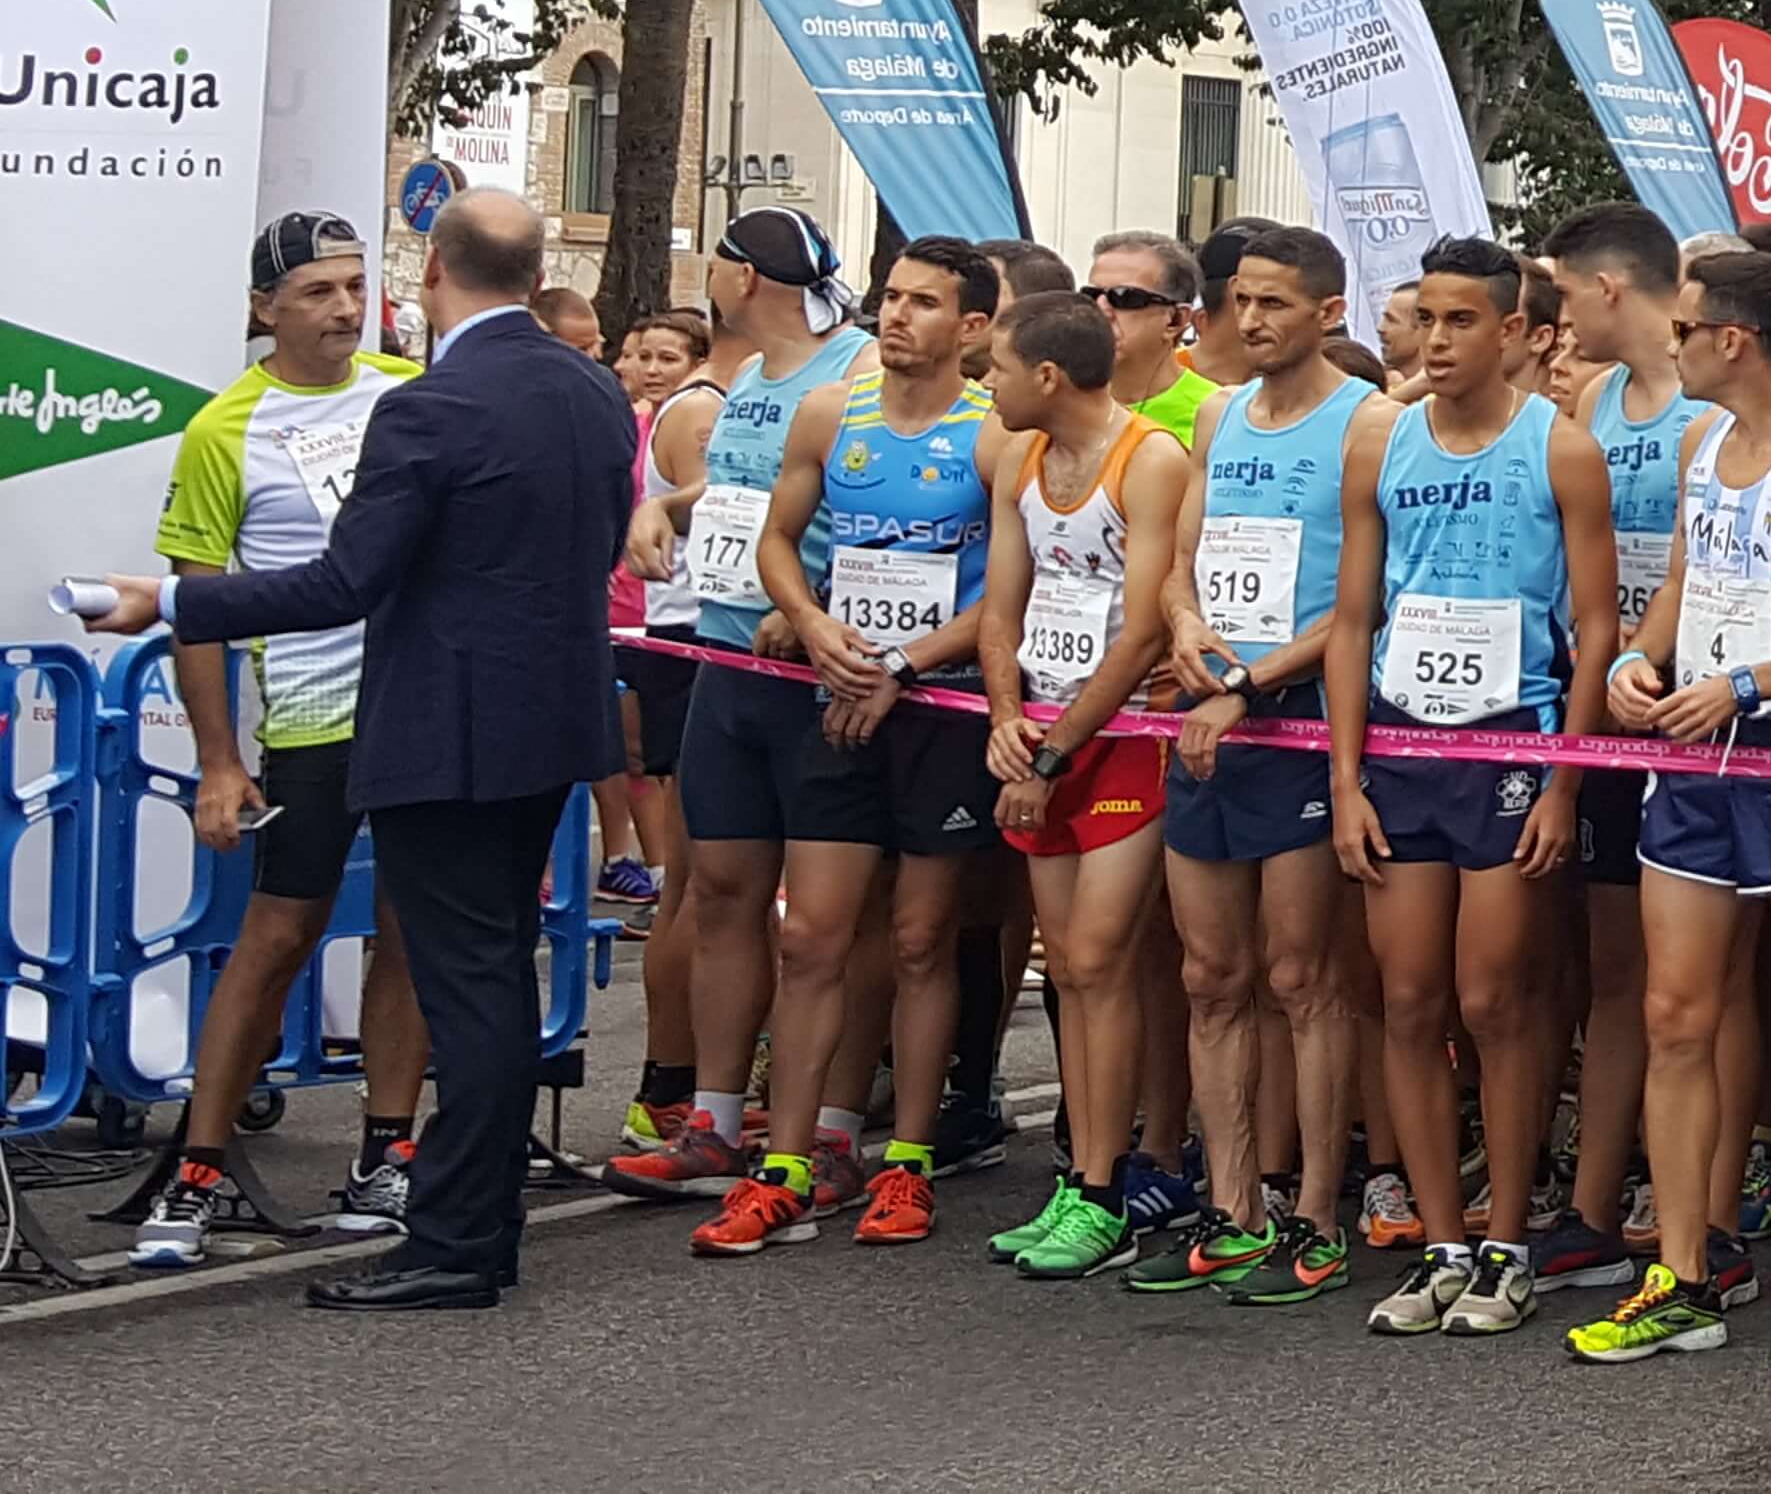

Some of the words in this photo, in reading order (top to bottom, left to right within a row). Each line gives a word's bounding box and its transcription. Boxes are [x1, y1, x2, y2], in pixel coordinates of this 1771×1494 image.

[0, 47, 220, 125] Unicaja
[1, 147, 222, 178] undación
[454, 136, 510, 166] MOLINA
[36, 368, 162, 434] Inglés
[1211, 456, 1275, 487] nerja
[1603, 436, 1662, 472] erja
[1395, 474, 1493, 512] nerja
[703, 533, 747, 567] 177
[1209, 571, 1261, 604] 519
[839, 595, 943, 632] 13384
[1028, 625, 1094, 666] 13389
[1711, 632, 1726, 665] 4
[1415, 651, 1484, 687] 525
